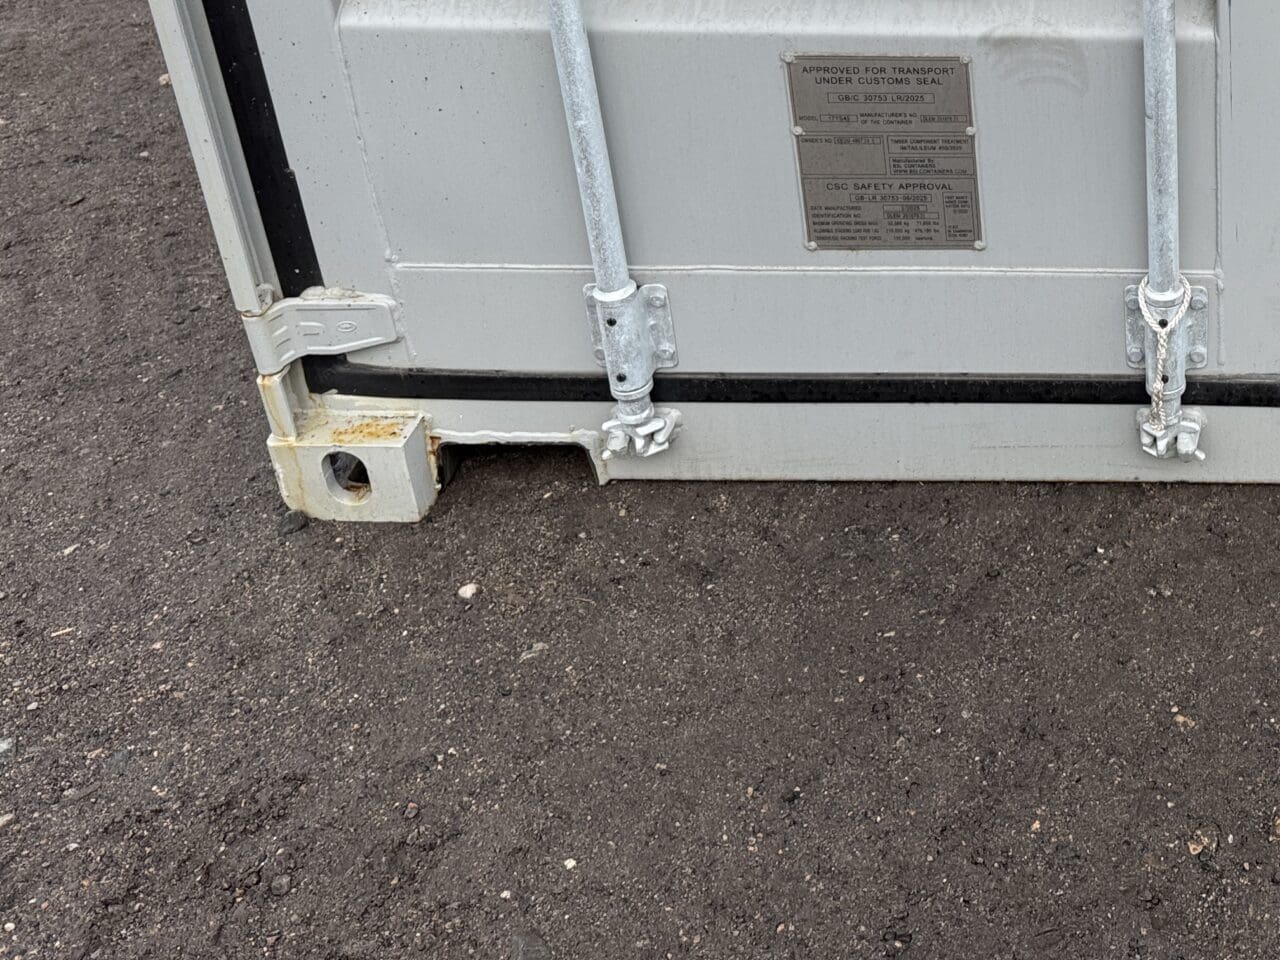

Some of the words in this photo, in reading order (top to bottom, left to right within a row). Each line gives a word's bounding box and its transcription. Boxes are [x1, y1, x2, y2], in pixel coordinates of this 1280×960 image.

[802, 66, 860, 75] APPROVED
[865, 67, 887, 75] FOR
[892, 67, 955, 76] TRANSPORT
[815, 76, 853, 85] UNDER
[858, 77, 911, 85] CUSTOMS
[916, 77, 943, 86] SEAL
[826, 182, 849, 191] CSC
[853, 183, 894, 191] SAFETY
[899, 183, 953, 191] APPROVAL
